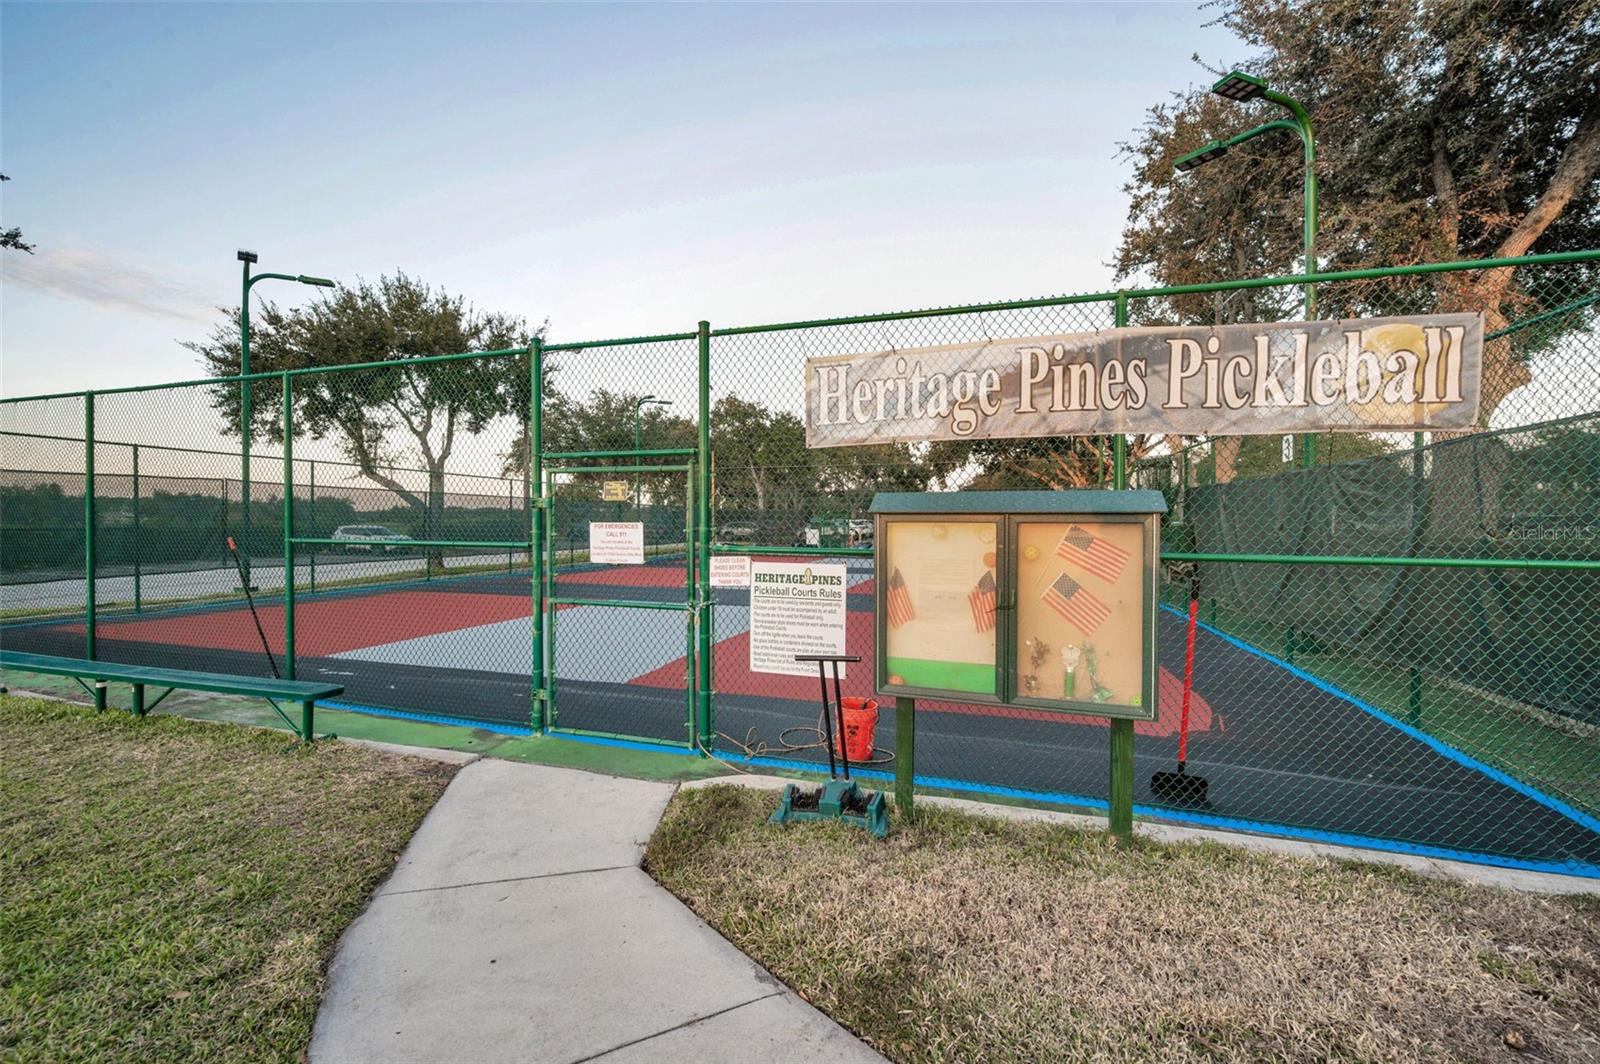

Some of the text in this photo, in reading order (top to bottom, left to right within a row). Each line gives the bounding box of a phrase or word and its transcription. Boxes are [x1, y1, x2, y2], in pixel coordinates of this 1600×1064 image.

[815, 325, 1466, 436] Heritage Pines Pickleball
[754, 573, 842, 586] HERITAGE PINES
[754, 586, 842, 598] Pickleball Courts Rules
